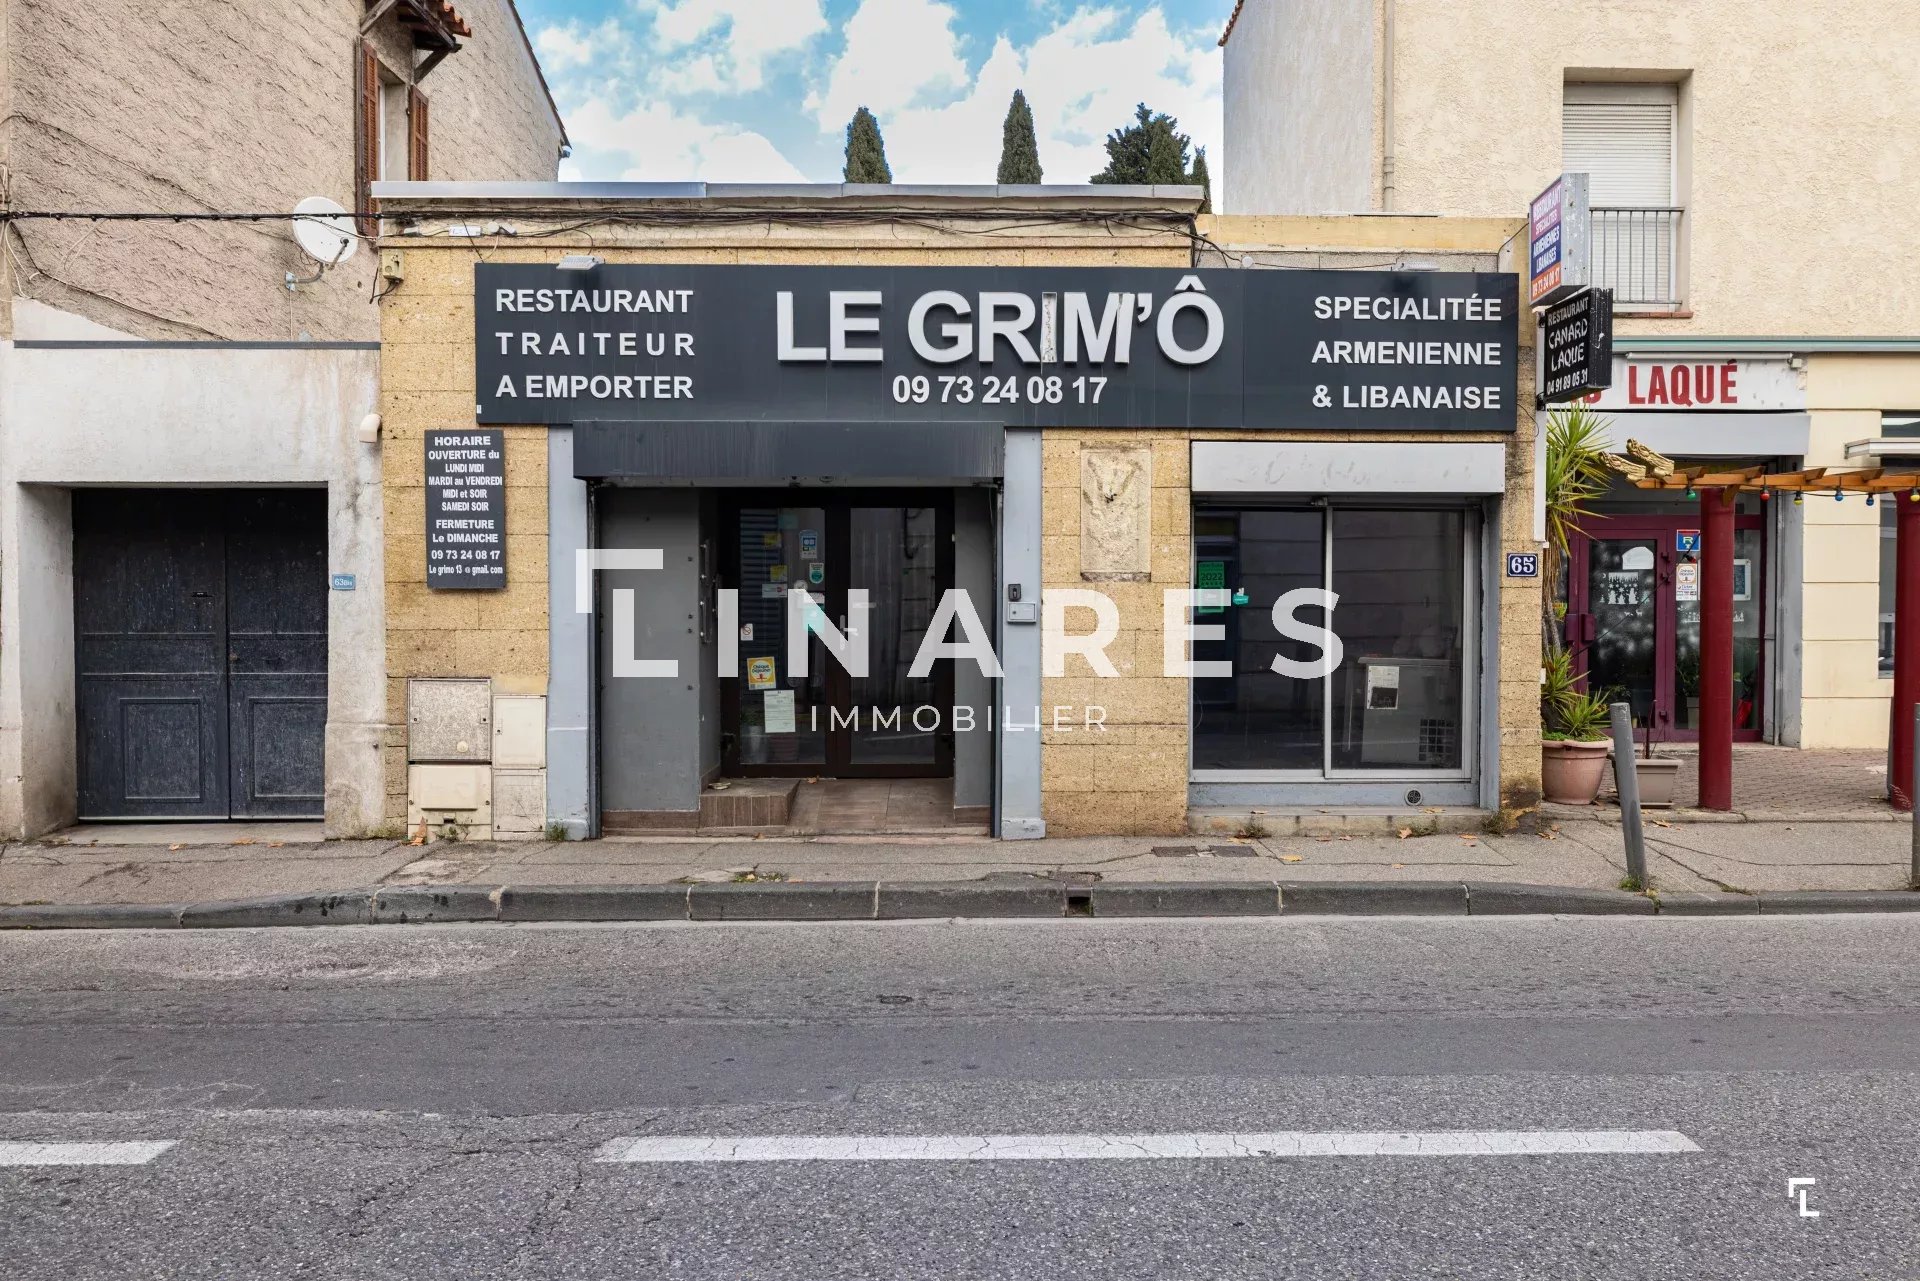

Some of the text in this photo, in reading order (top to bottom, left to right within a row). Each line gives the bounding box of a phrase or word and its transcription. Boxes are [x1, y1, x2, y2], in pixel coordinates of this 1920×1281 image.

[496, 289, 694, 312] RESTAURANT
[1314, 293, 1502, 321] SPECIALITÉE
[1548, 296, 1589, 326] RESTAURANT
[776, 290, 883, 363] LE
[1548, 318, 1588, 350] CANARD
[495, 332, 695, 356] TRAITEUR
[1311, 340, 1502, 365] ARMENIENNE
[1551, 342, 1585, 372] LAQUE
[495, 374, 694, 399] A EMPORTER
[892, 375, 1108, 404] 09 73 24 08 17
[1547, 381, 1555, 396] 04
[1555, 377, 1562, 391] 91
[1563, 374, 1571, 390] 89
[1572, 371, 1580, 387] 05
[1581, 368, 1588, 384] 31
[1628, 359, 1738, 407] LAQUÉ
[1312, 384, 1501, 409] & LIBANAISE
[434, 436, 491, 446] HORAIRE
[428, 450, 500, 460] OUVERTURE du
[445, 463, 484, 473] LUNDI MIDI
[428, 476, 503, 486] MARDI au VENDREDI
[442, 488, 487, 498] MIDI et SOIR
[441, 502, 489, 511] SAMEDI SOIR
[436, 520, 495, 529] FERMETURE
[432, 533, 498, 543] Le DIMANCHE
[431, 550, 501, 560] 09 73 24 08 17
[1511, 556, 1534, 573] 65
[428, 565, 437, 574] Le
[438, 565, 454, 576] grimo
[456, 565, 463, 574] 13
